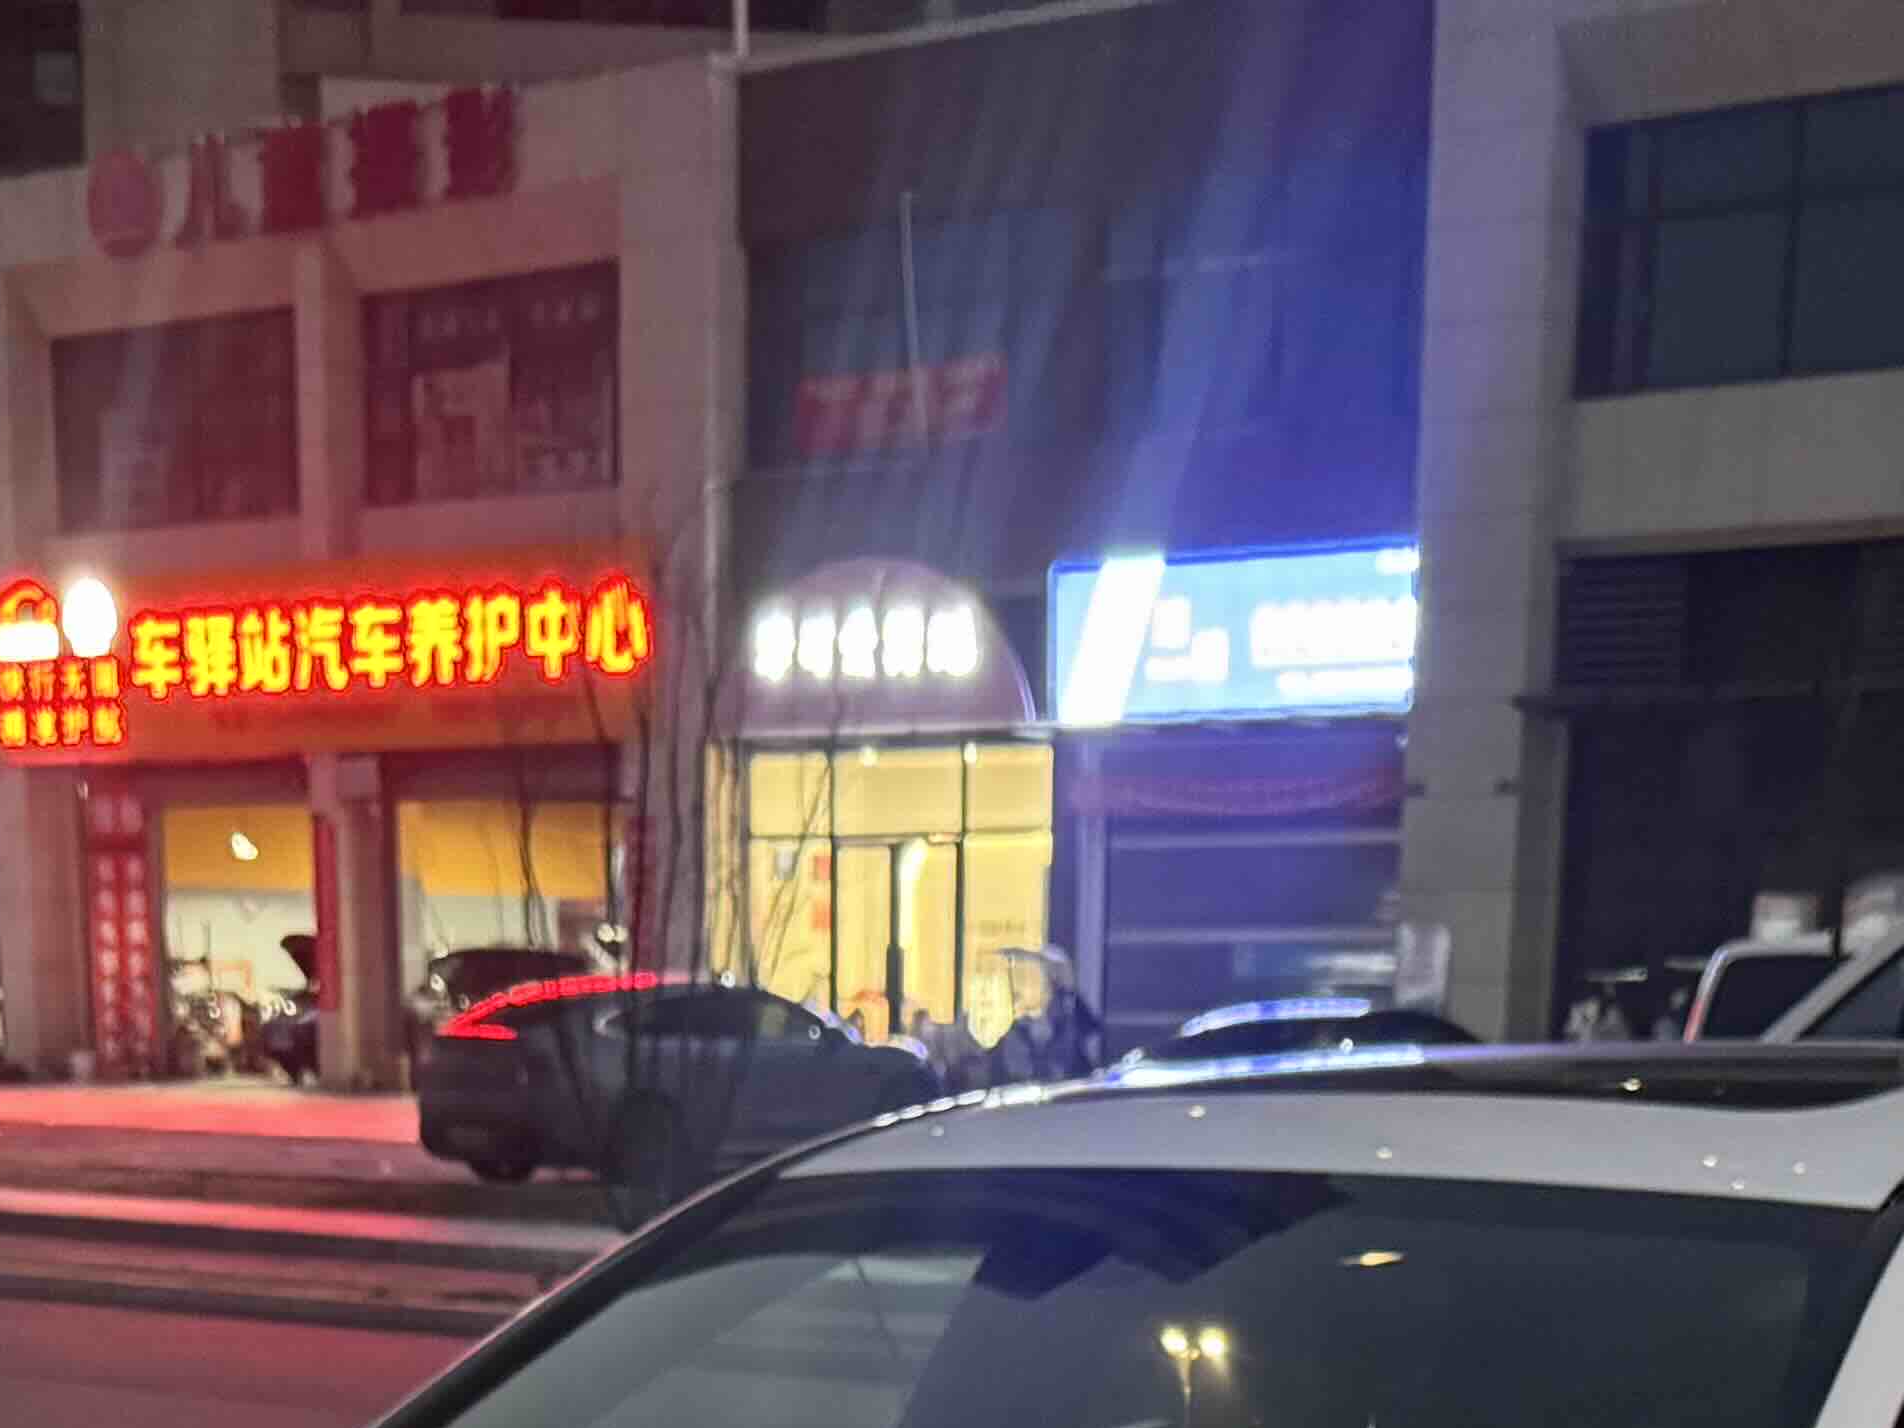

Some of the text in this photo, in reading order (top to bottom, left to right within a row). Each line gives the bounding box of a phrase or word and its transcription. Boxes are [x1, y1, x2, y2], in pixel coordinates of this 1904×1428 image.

[132, 584, 649, 698] 车驿站汽车养护中心
